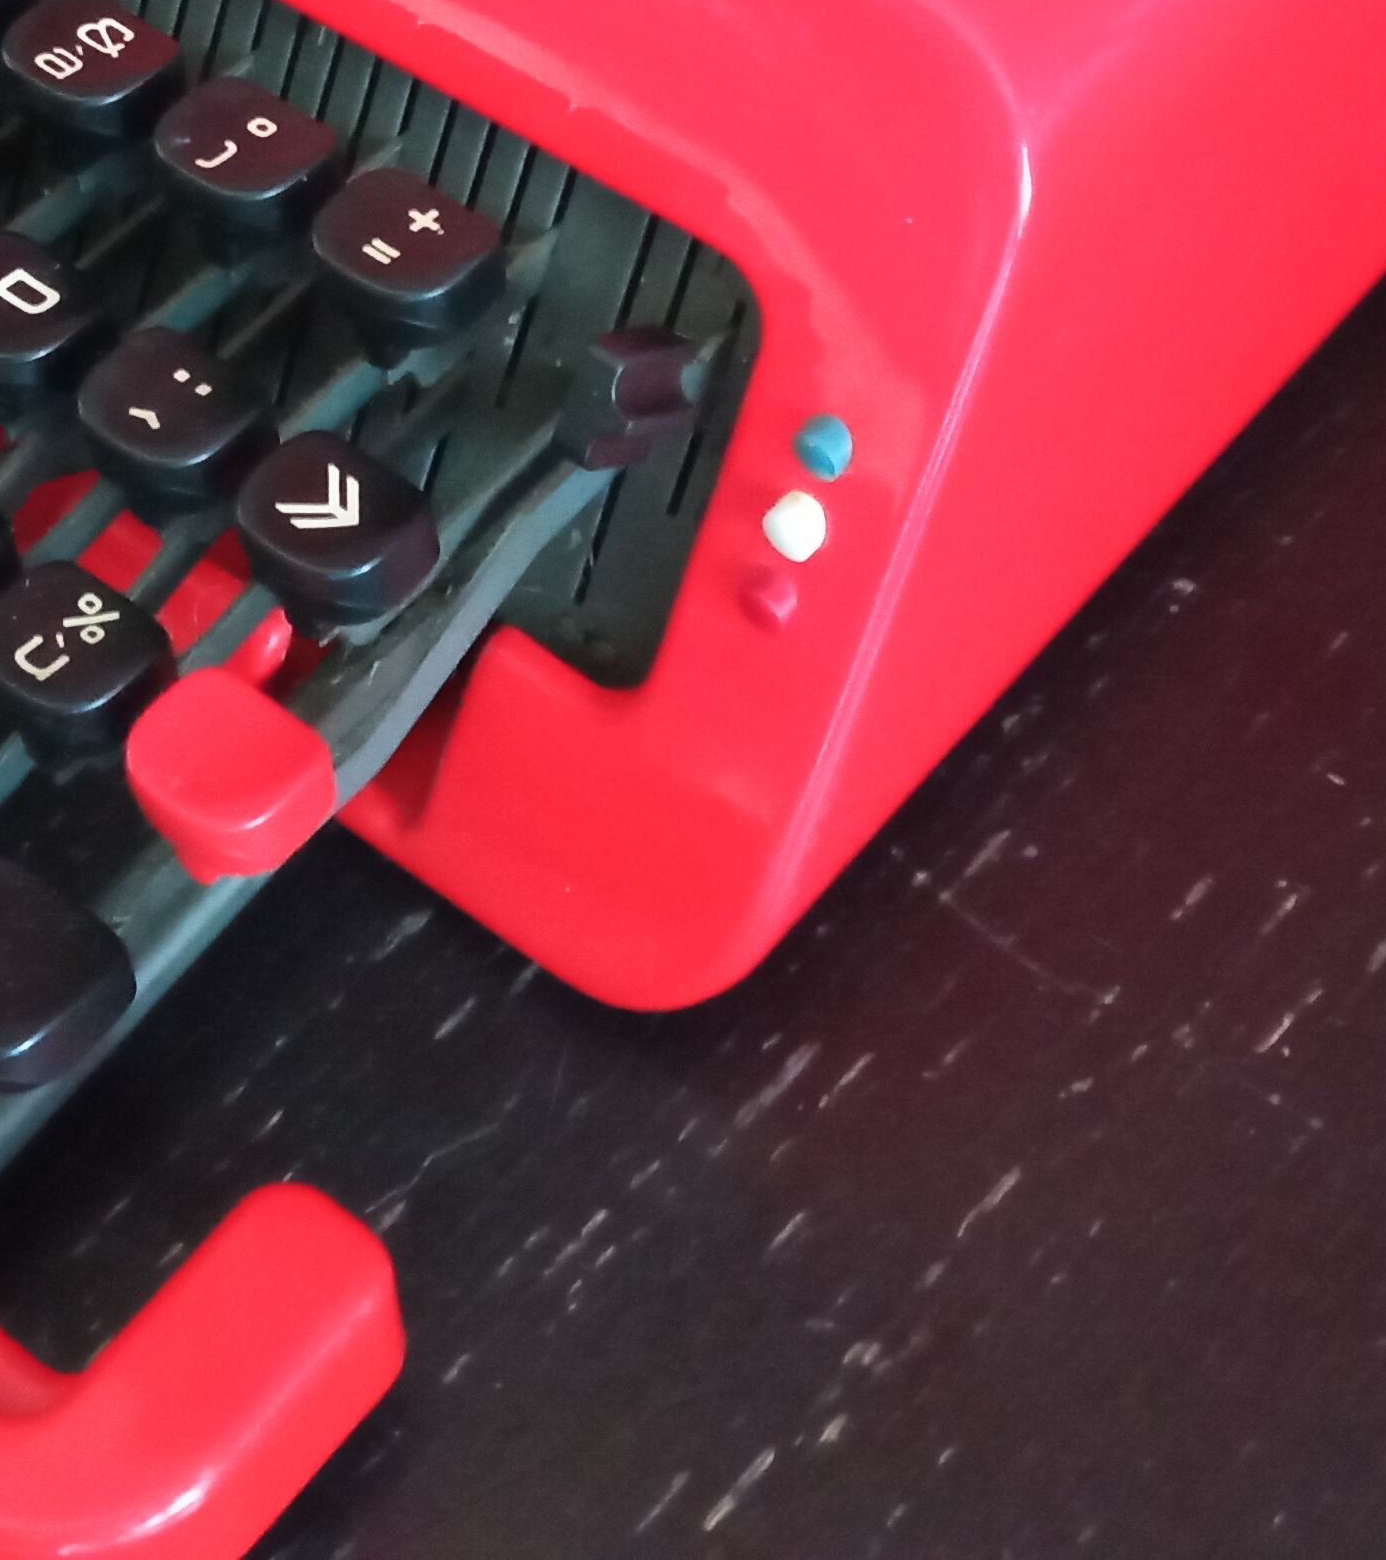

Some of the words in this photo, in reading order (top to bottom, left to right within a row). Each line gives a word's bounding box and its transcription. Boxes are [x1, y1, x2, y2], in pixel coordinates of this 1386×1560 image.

[34, 45, 84, 80] à
[362, 237, 401, 265] =
[63, 592, 120, 643] %
[14, 632, 70, 681] ù
